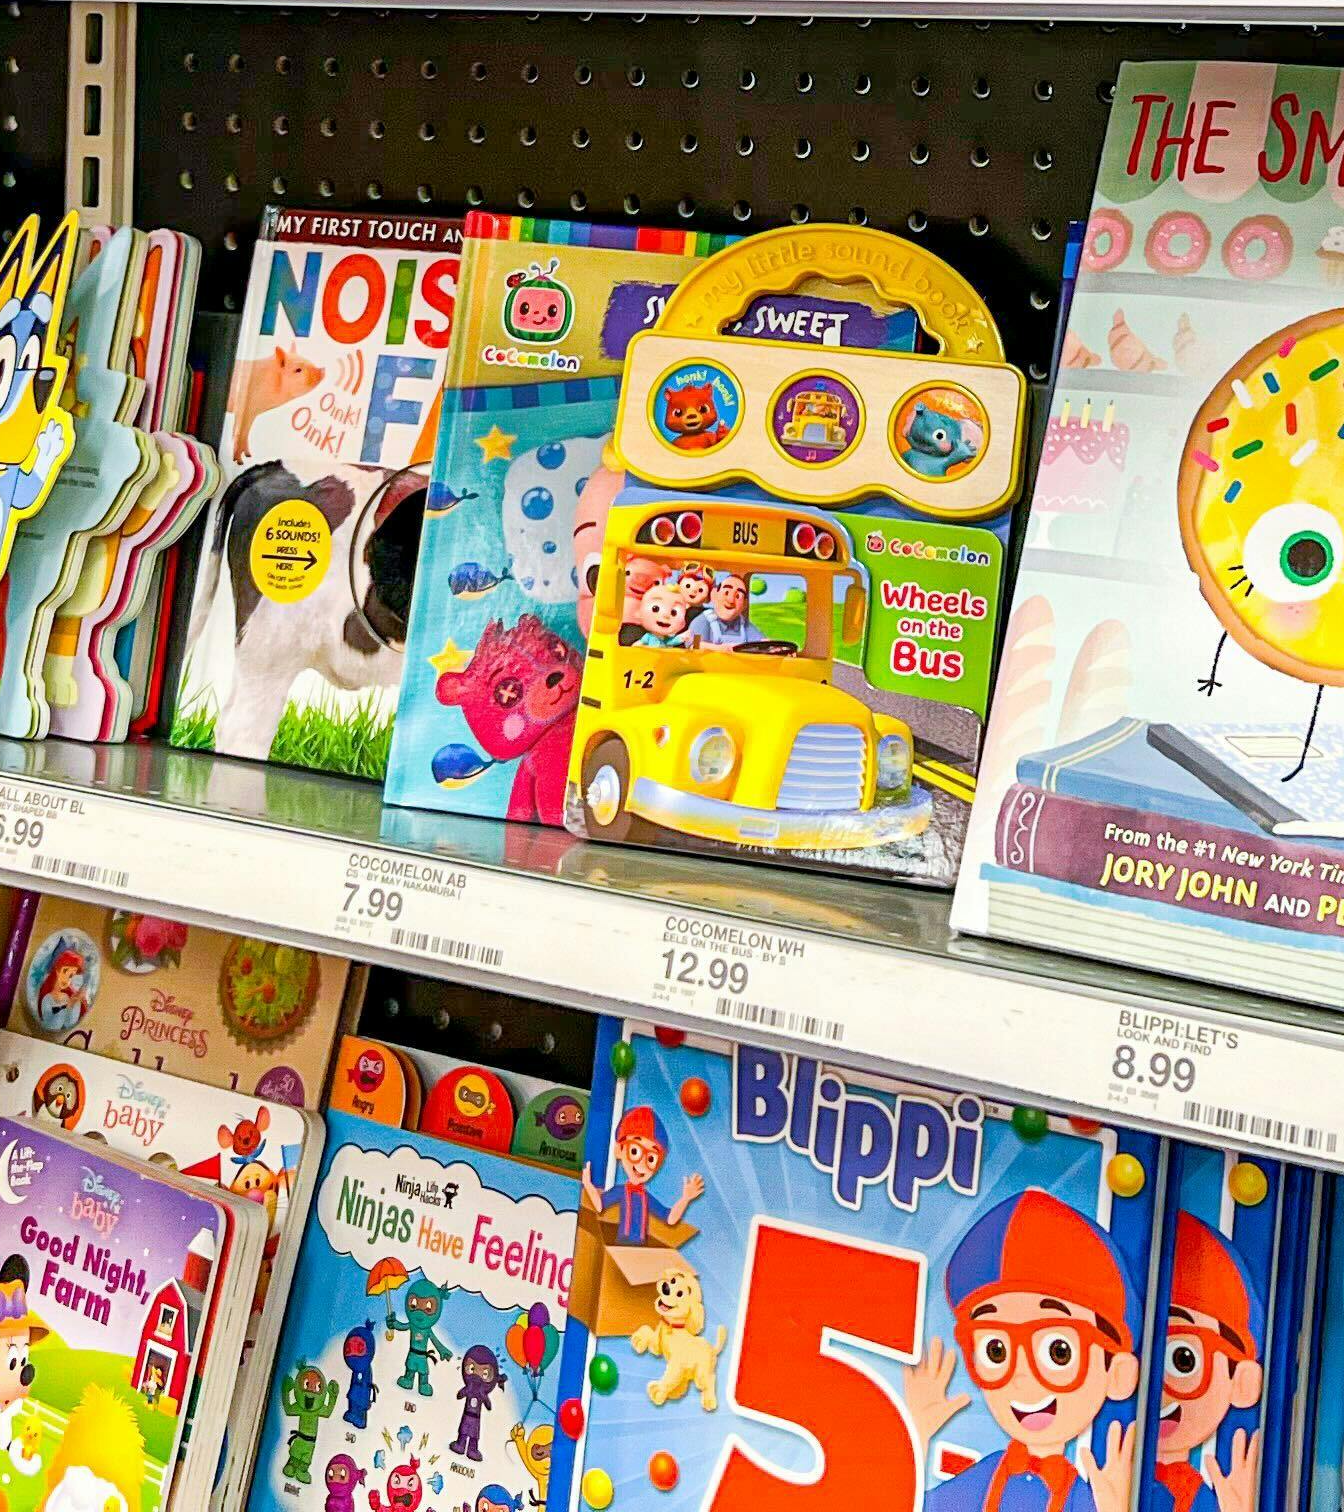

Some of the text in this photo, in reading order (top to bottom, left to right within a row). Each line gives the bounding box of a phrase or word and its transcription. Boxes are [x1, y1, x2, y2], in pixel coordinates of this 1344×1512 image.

[1125, 93, 1229, 180] THE
[275, 215, 437, 243] MY FIRST TOUCH
[290, 406, 346, 458] Oink!
[277, 517, 311, 528] Includes
[731, 521, 759, 547] BUS
[275, 563, 294, 571] HERE
[276, 546, 298, 555] PRESS
[879, 582, 987, 619] Wheels
[897, 618, 961, 639] on the
[890, 638, 964, 681] Bus
[22, 791, 67, 811] ABOUT
[348, 853, 444, 885] COCOMELON
[1104, 822, 1151, 848] From
[1156, 832, 1188, 855] the
[1192, 840, 1216, 860] #1
[1221, 846, 1265, 869] New
[1269, 853, 1315, 879] York
[343, 882, 404, 922] 7.99
[1099, 852, 1176, 892] JORY
[1175, 872, 1258, 909] JOHN
[1263, 893, 1311, 919] AND
[665, 916, 773, 952] COCOMELON
[661, 948, 749, 995] 12.99
[120, 1005, 209, 1058] PRINCESS
[1116, 1027, 1212, 1057] LOOK FIND
[1118, 1009, 1240, 1050] BLIPPI:LET'S
[1112, 1044, 1197, 1094] 8.99
[102, 1099, 165, 1147] baby
[733, 1044, 986, 1213] Blippi
[71, 1192, 122, 1237] baby
[335, 1173, 465, 1260] Ninjas Have
[20, 1215, 152, 1304] Good Night,
[38, 1257, 112, 1328] Farm
